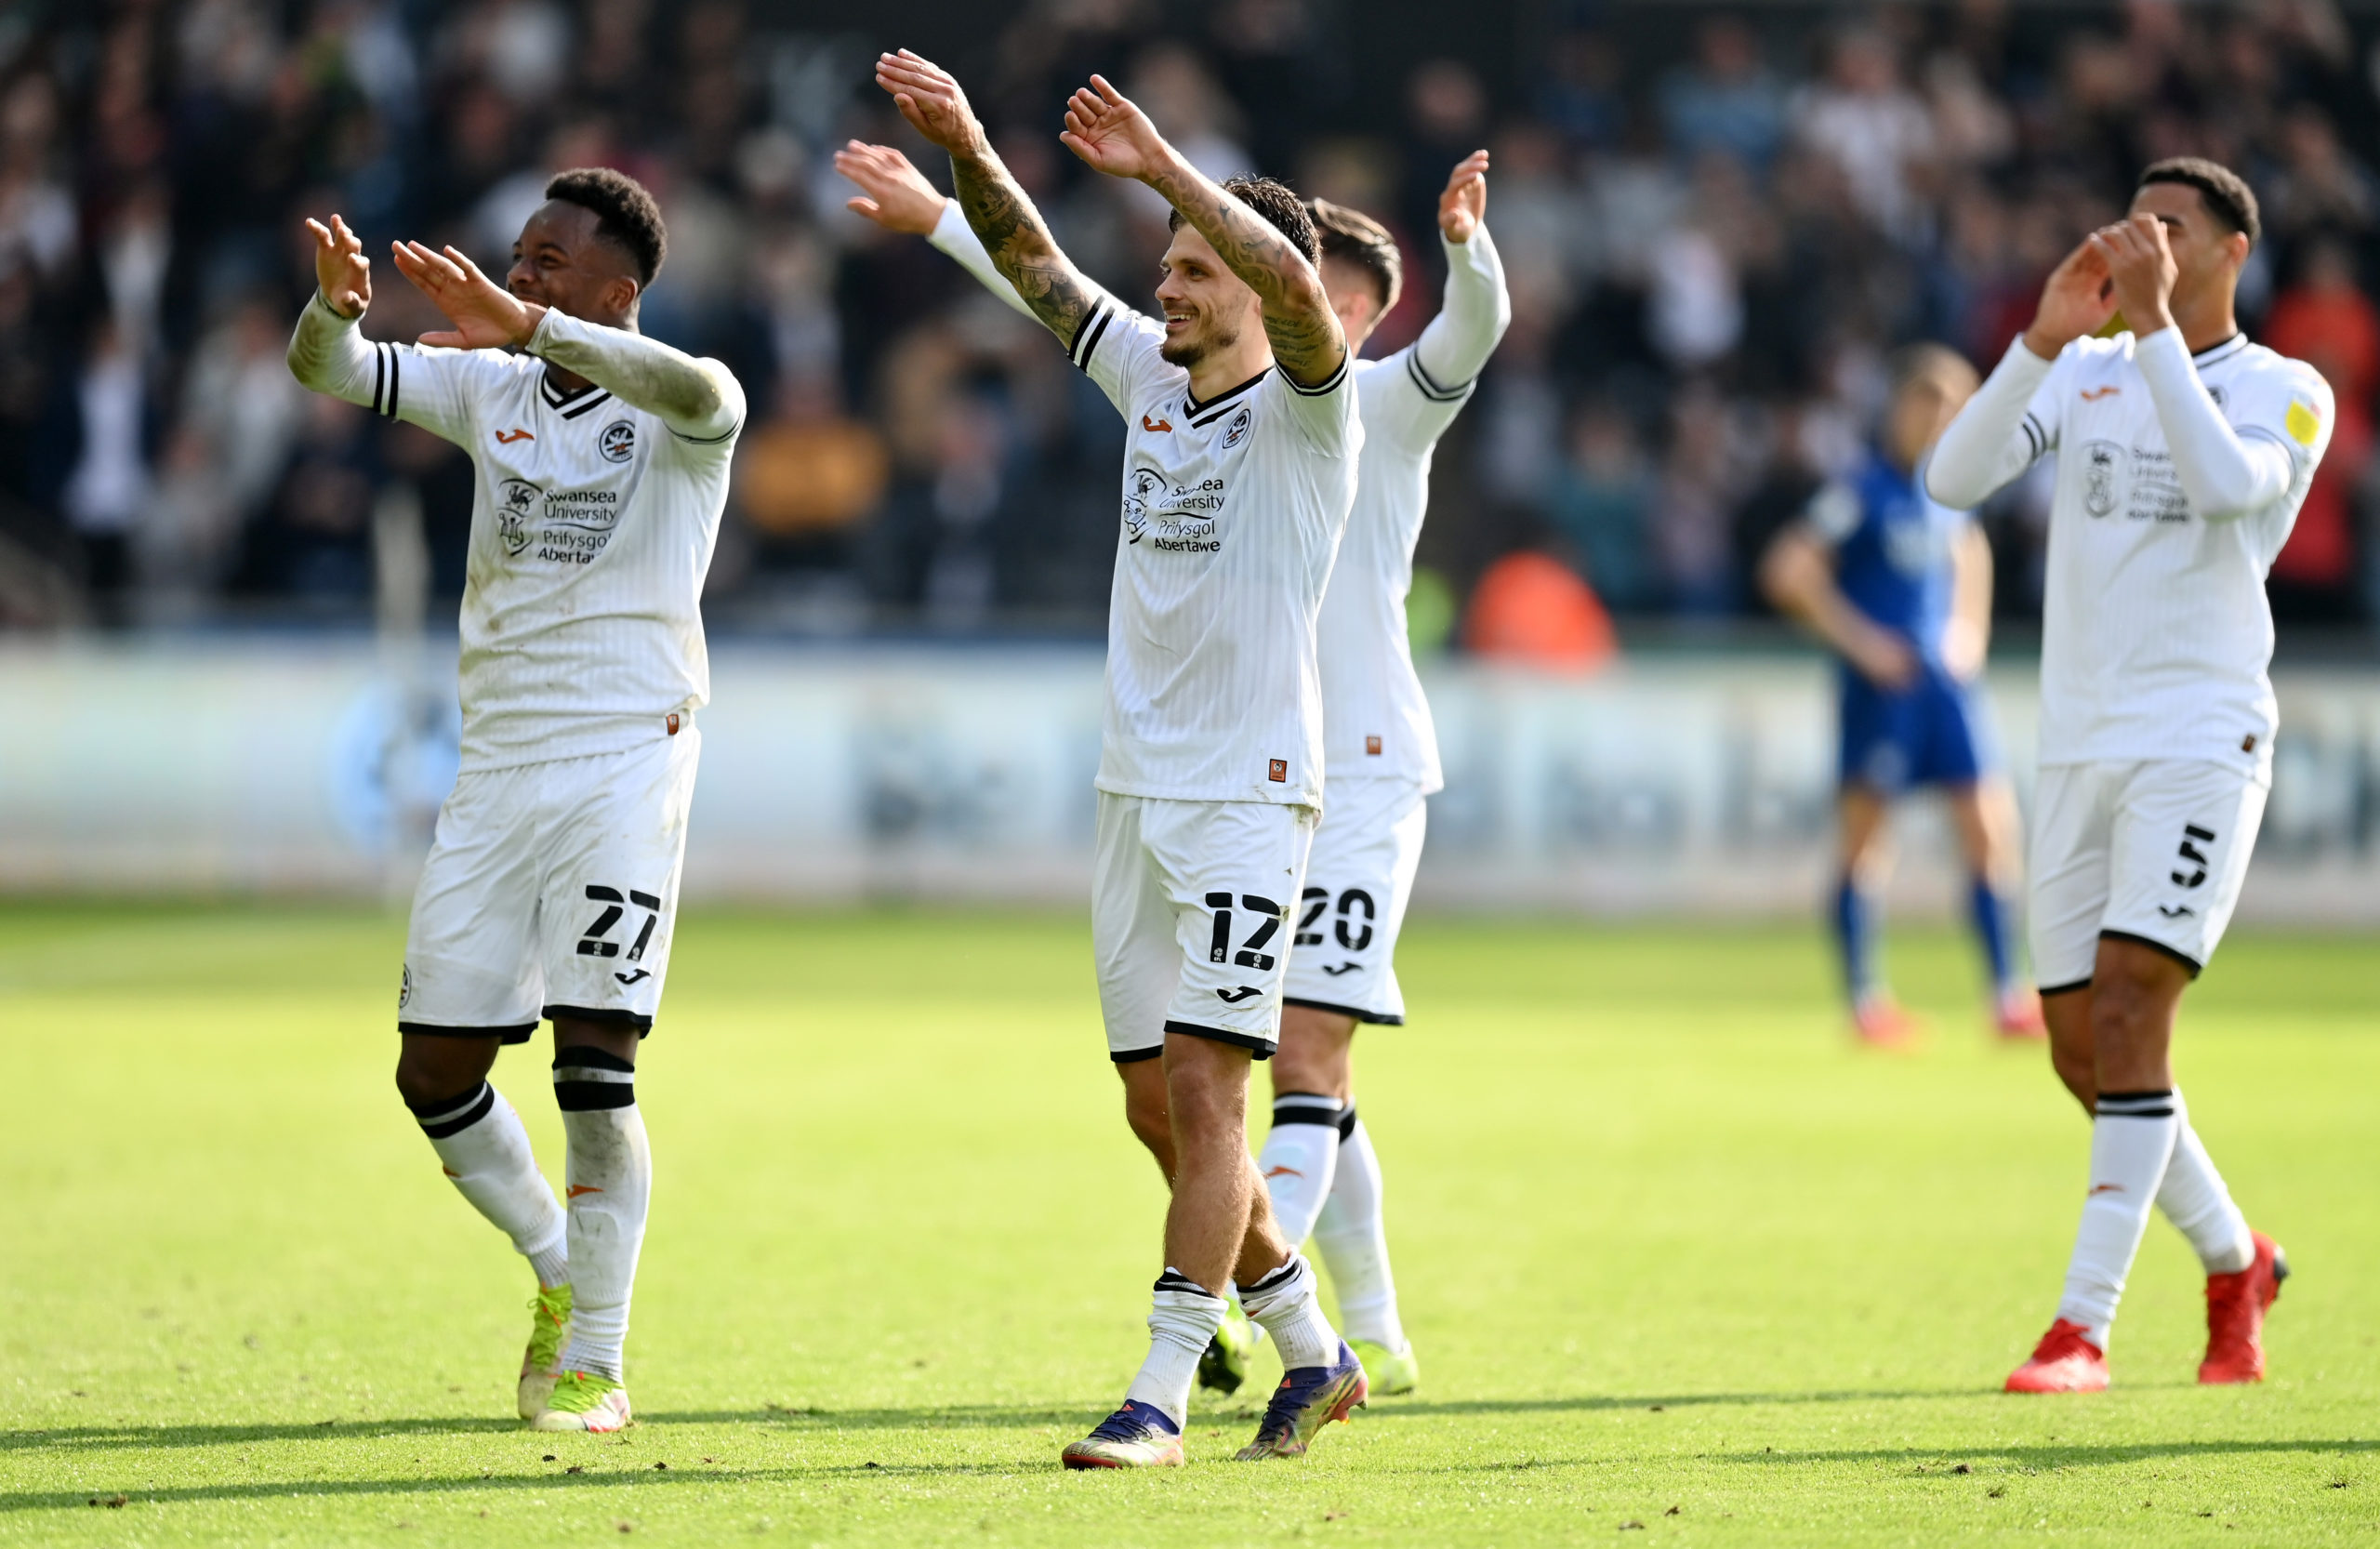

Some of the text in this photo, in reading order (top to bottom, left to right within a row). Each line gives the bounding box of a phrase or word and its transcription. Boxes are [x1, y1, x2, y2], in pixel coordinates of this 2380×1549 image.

[544, 489, 616, 503] Swansea
[544, 504, 617, 523] University
[1158, 520, 1215, 538] Prifysgol
[1155, 537, 1221, 552] Abertawe
[537, 547, 595, 563] Aberta
[2171, 824, 2215, 888] 5
[576, 885, 660, 961] 27
[1294, 888, 1374, 951] 20
[1206, 893, 1280, 971] 12
